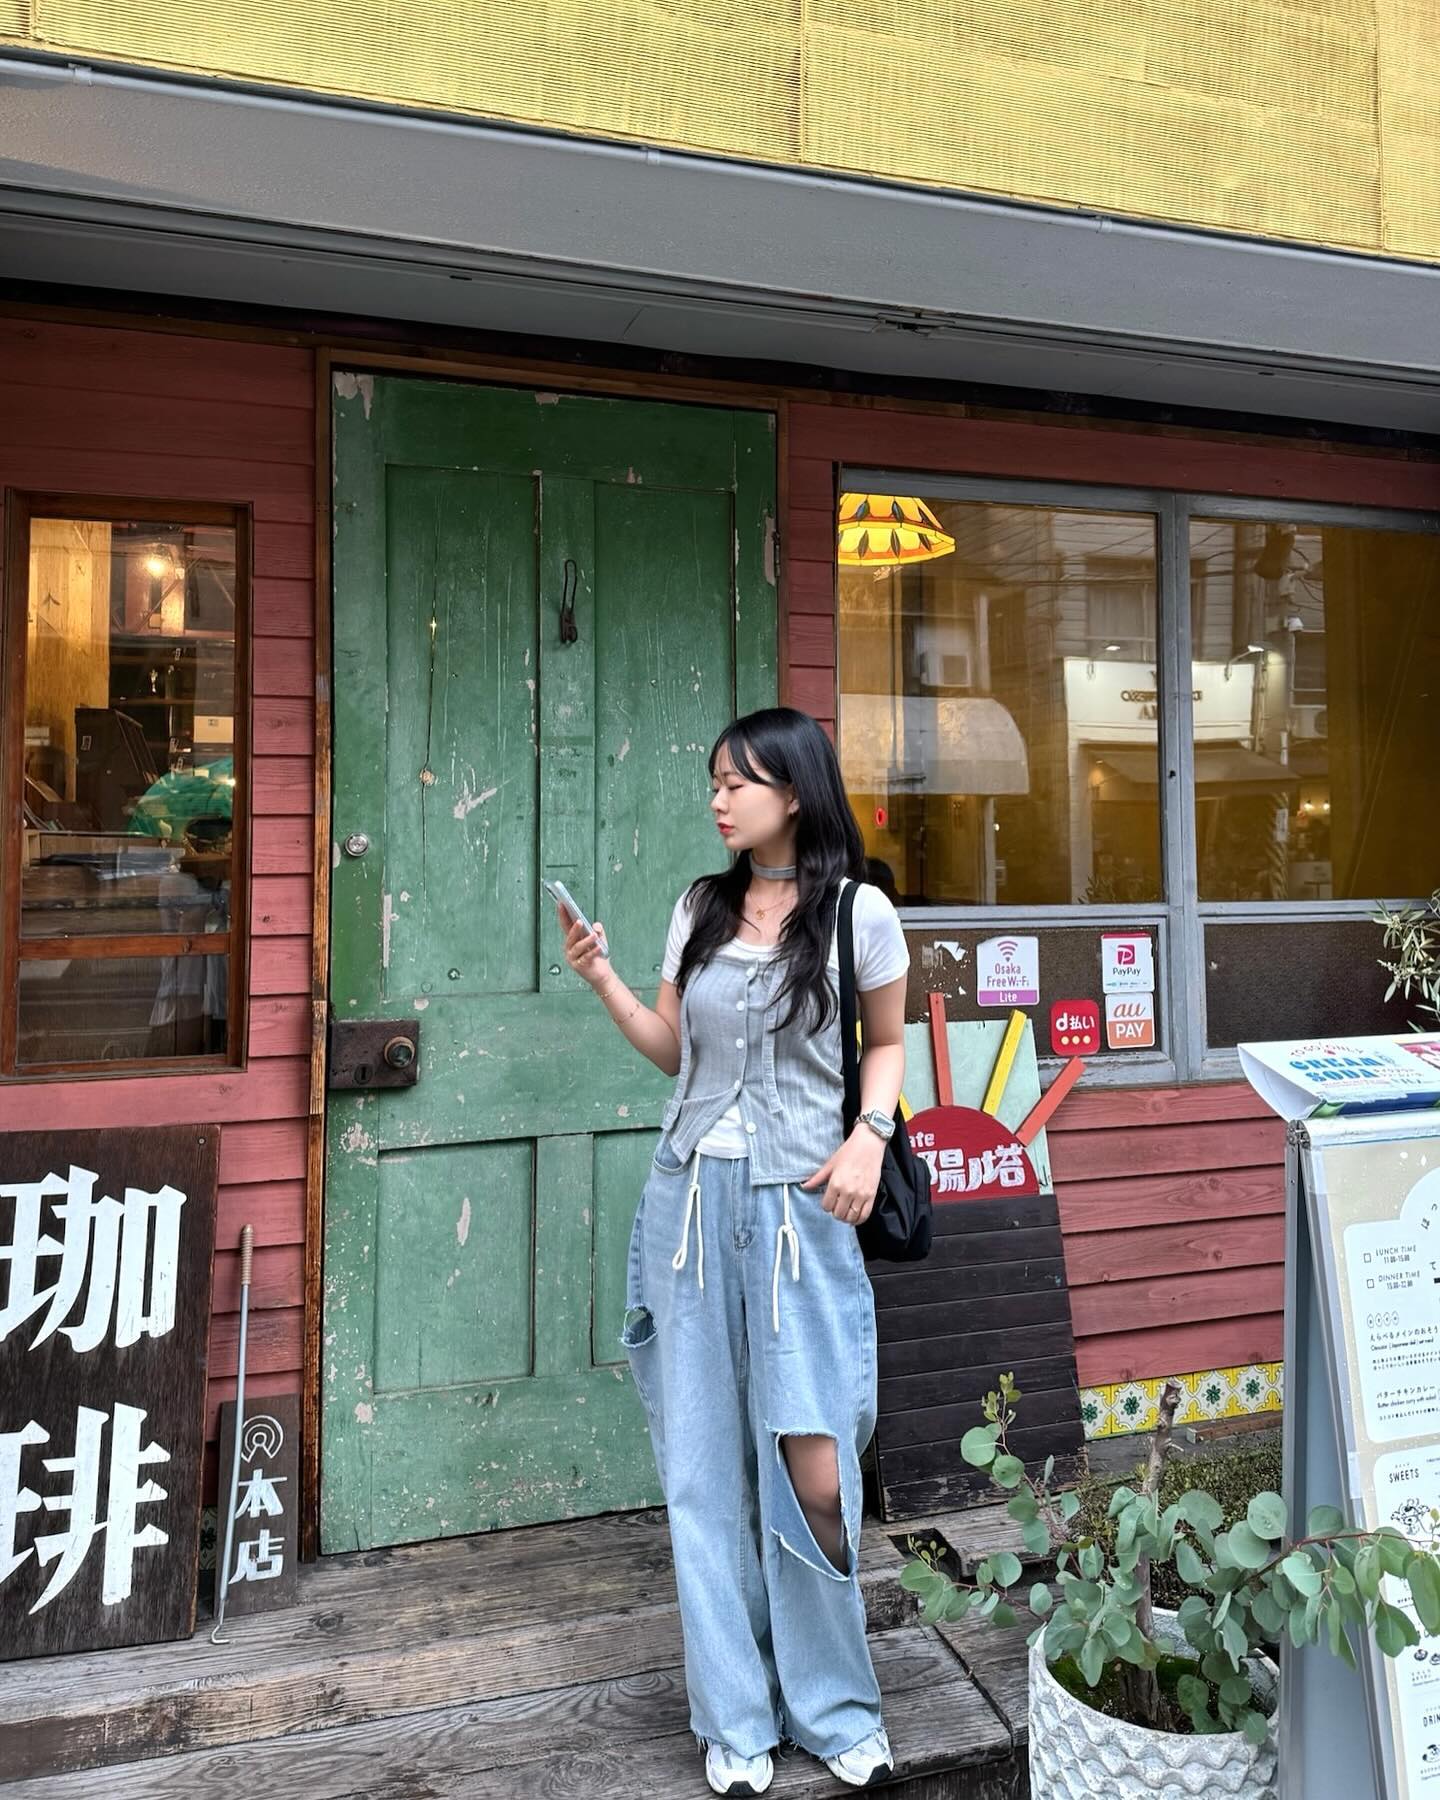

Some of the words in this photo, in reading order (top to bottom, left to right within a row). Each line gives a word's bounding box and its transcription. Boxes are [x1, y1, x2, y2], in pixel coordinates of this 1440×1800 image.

[994, 962, 1021, 975] Osaka
[1112, 966, 1141, 977] PayPay
[987, 976, 1007, 987] Free
[999, 991, 1017, 1003] Lite
[1113, 1002, 1146, 1018] au
[1056, 1012, 1095, 1031] d払い
[1115, 1021, 1145, 1039] PAY
[1290, 1056, 1384, 1071] CREAM
[1305, 1068, 1379, 1083] SODA
[1375, 1247, 1399, 1257] LUNCH
[1401, 1244, 1417, 1253] TIME
[1378, 1272, 1403, 1283] DINNER
[1405, 1270, 1420, 1278] TIME
[0, 1165, 187, 1615] 珈琲
[1389, 1468, 1420, 1484] SWEETS
[230, 1468, 288, 1584] 本店
